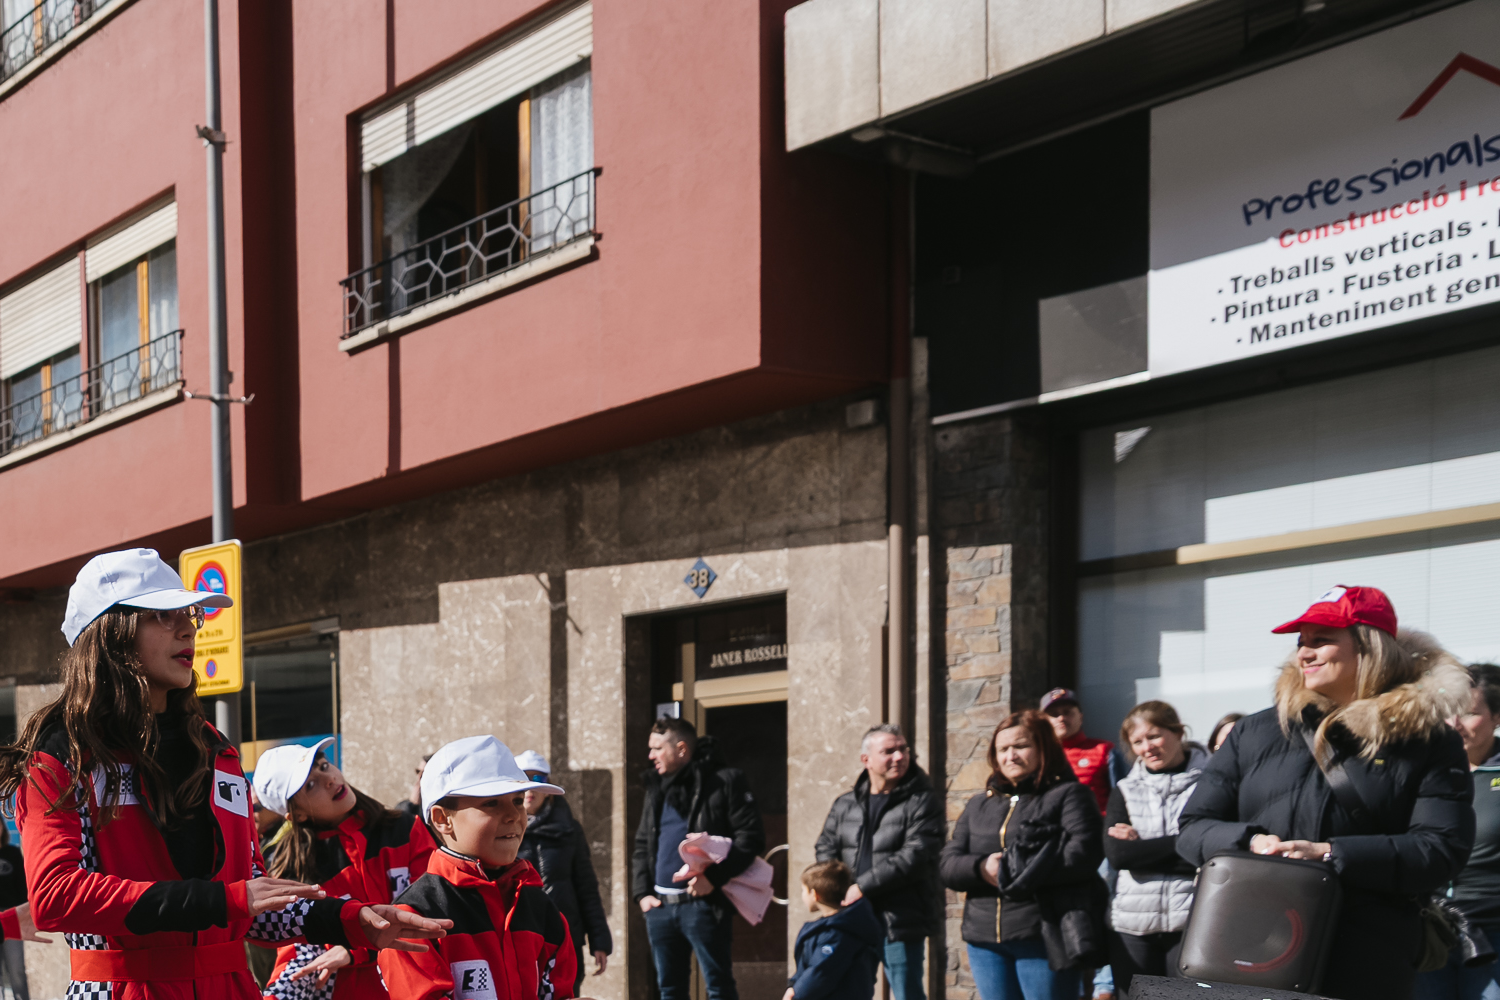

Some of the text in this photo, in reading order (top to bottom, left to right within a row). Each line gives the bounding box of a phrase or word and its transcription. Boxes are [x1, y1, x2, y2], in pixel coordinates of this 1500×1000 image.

[1278, 183, 1449, 248] Construcció
[1224, 288, 1320, 323] Pintura
[1343, 252, 1462, 295] Fusteria
[1230, 220, 1472, 295] Treballs verticals
[1250, 284, 1437, 344] Manteniment
[687, 567, 710, 589] 38
